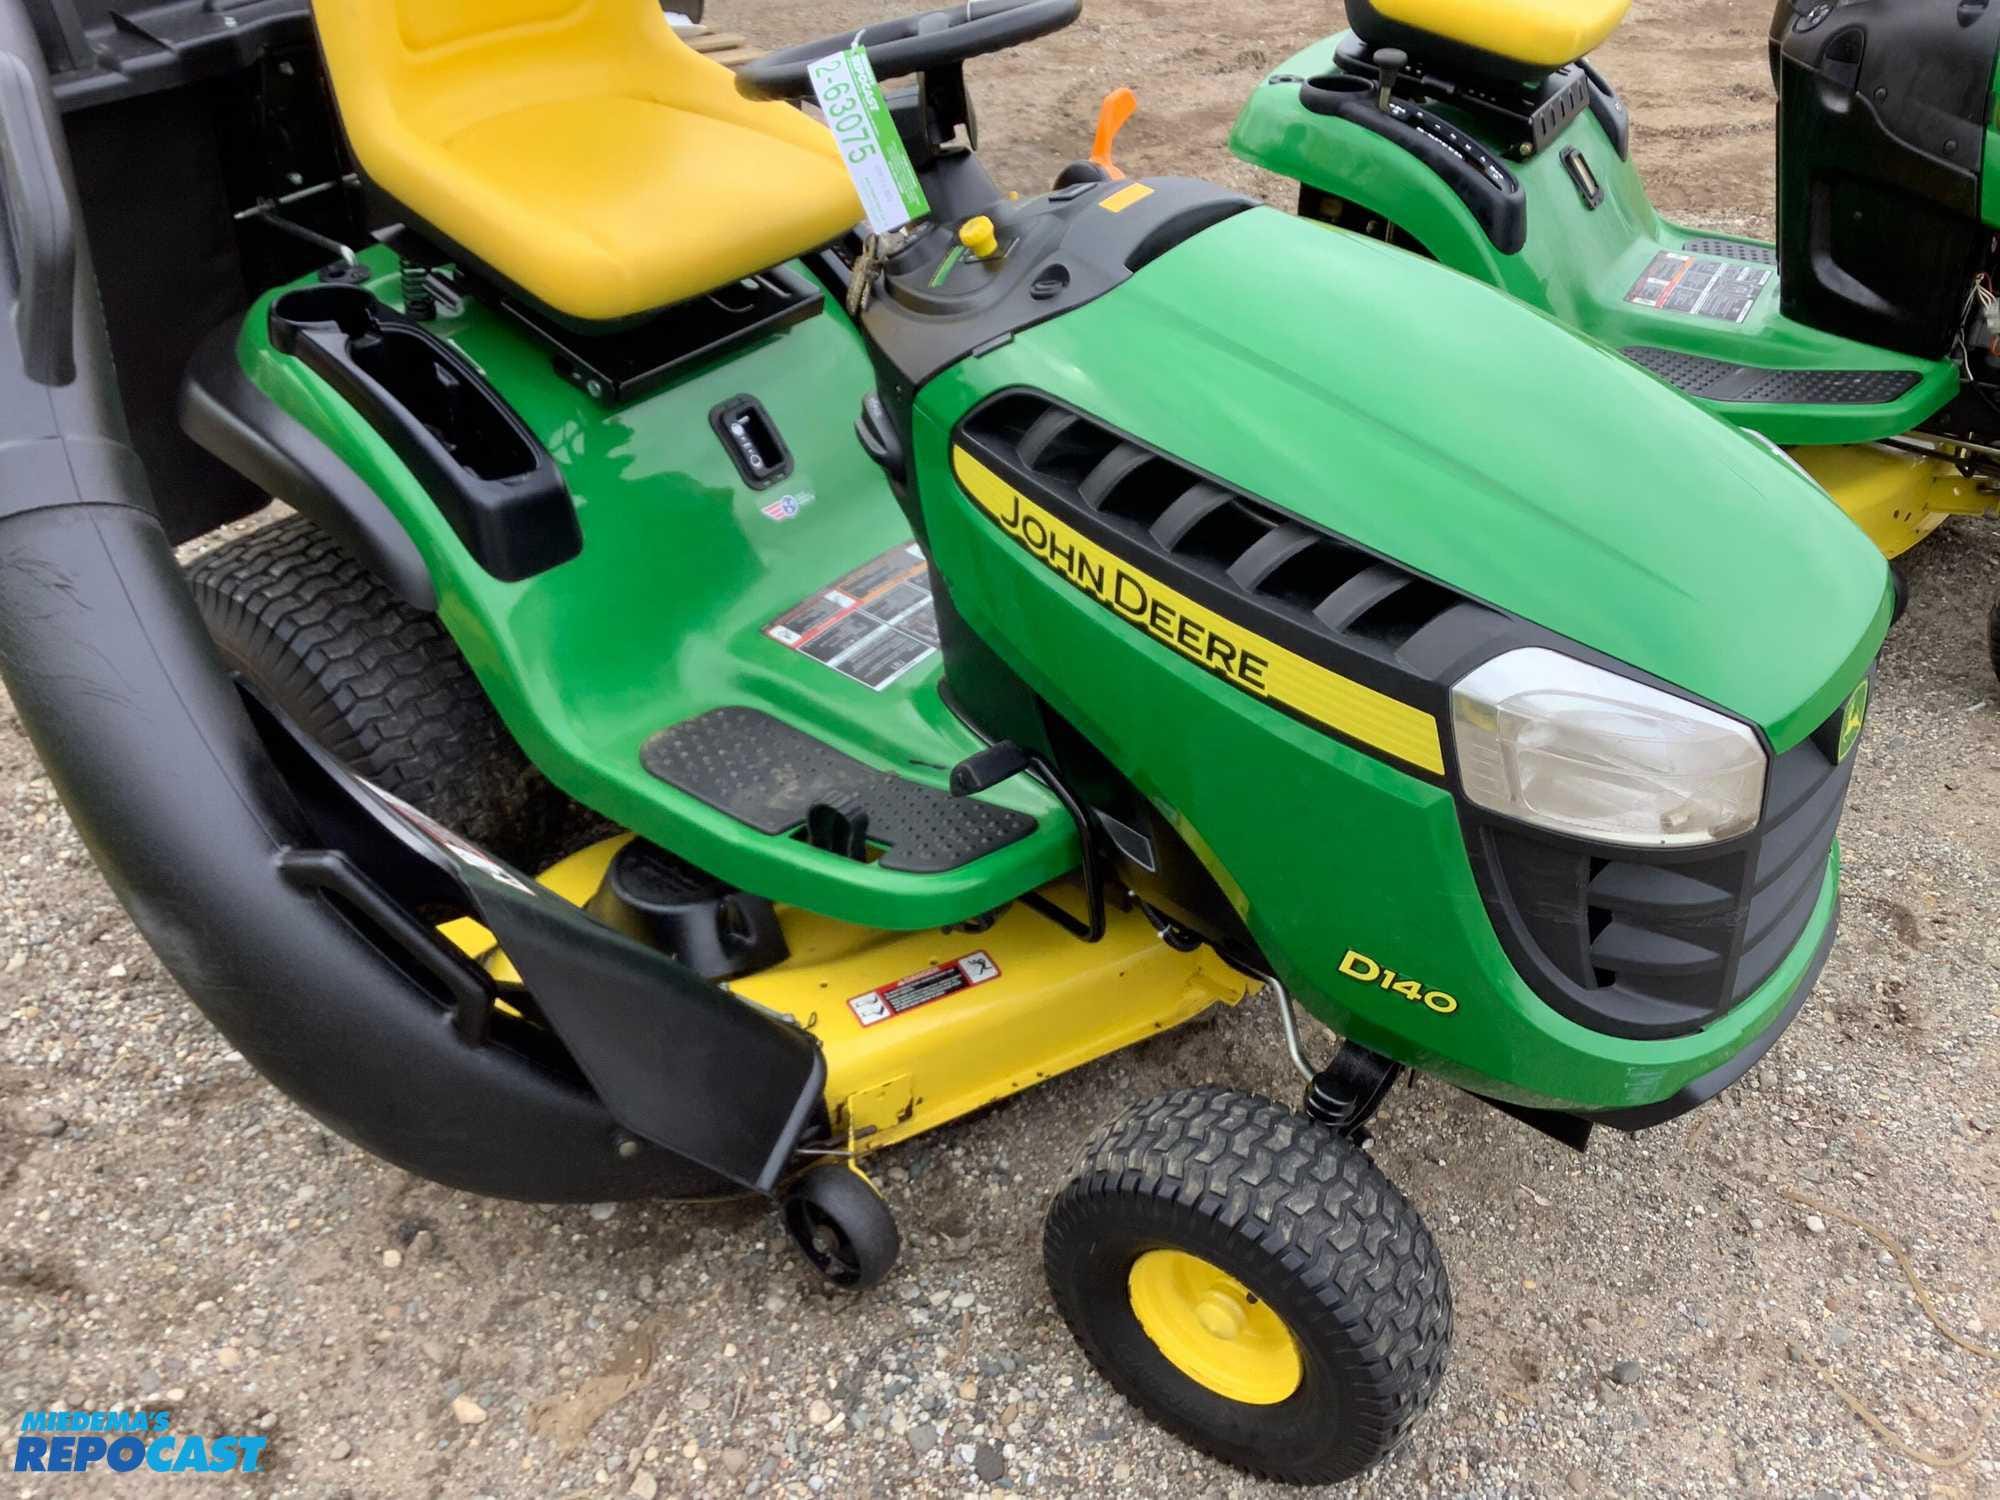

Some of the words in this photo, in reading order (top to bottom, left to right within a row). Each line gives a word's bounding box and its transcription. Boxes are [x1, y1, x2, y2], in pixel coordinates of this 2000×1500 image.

[815, 59, 877, 164] 2-63075
[1001, 496, 1105, 594] JOHN
[1113, 568, 1269, 690] DEERE
[1338, 949, 1458, 1014] D140
